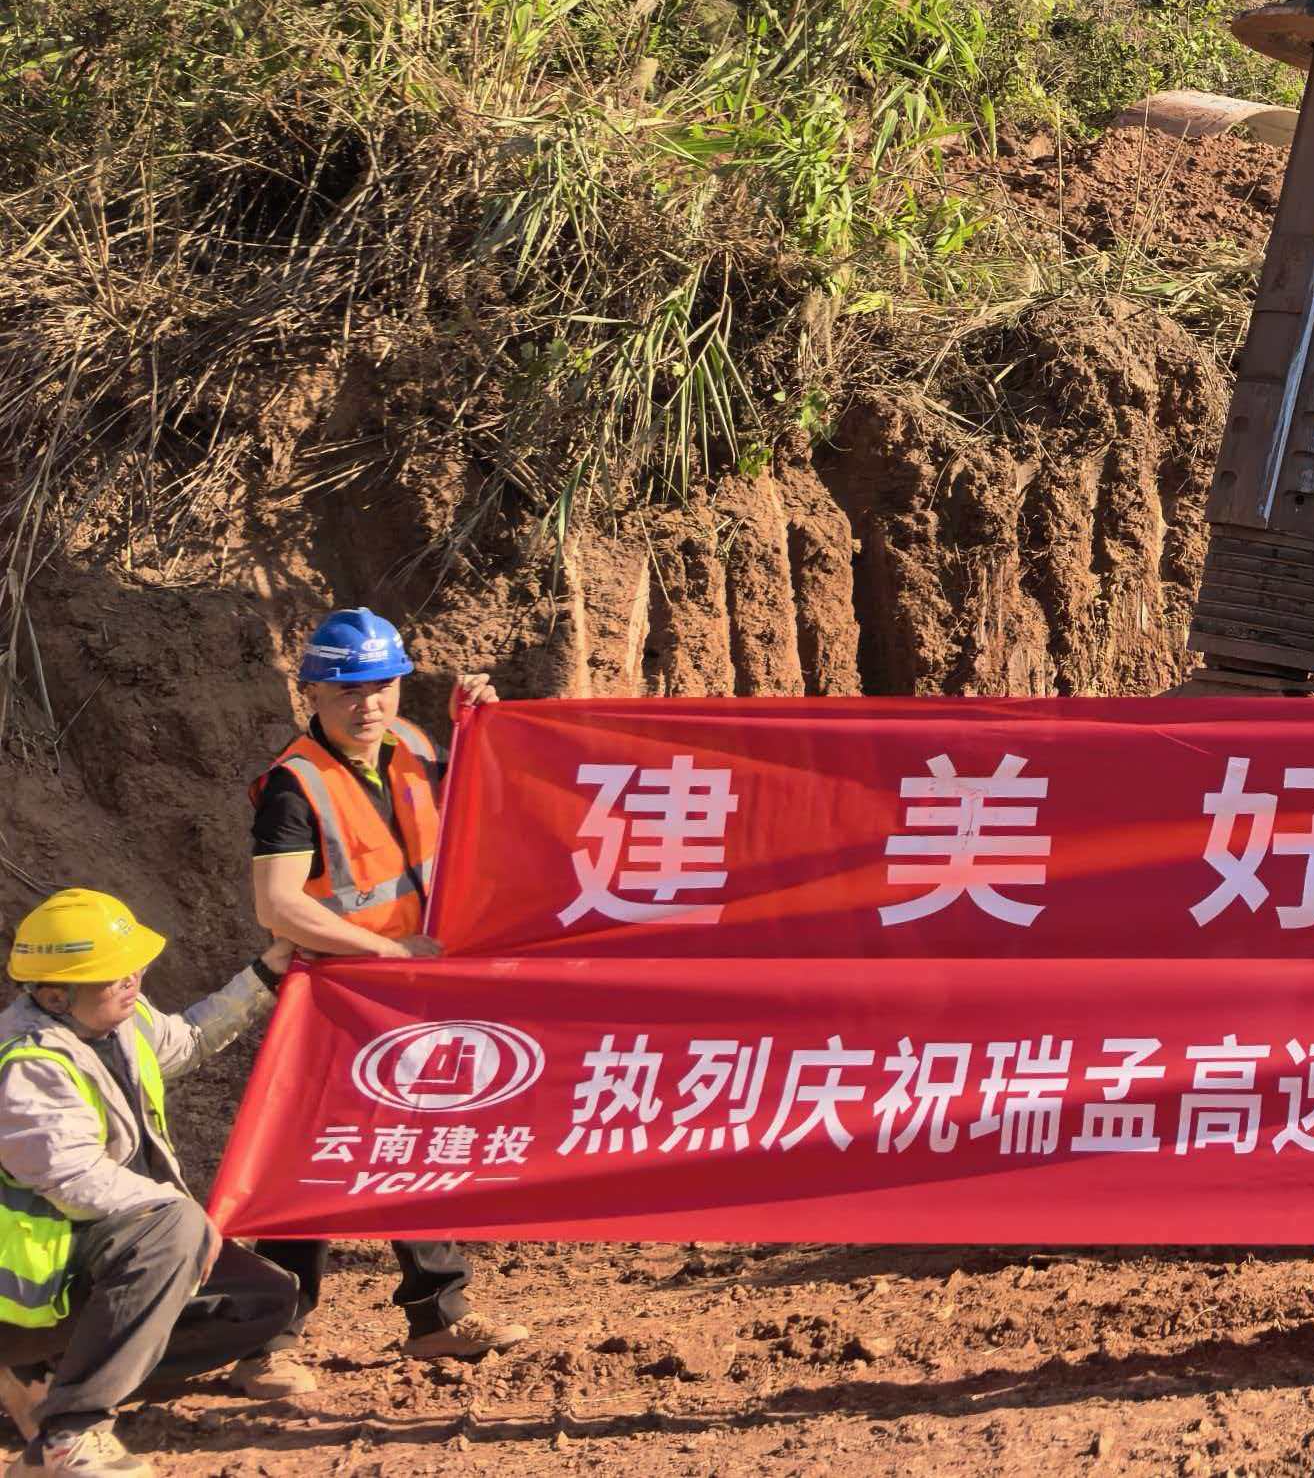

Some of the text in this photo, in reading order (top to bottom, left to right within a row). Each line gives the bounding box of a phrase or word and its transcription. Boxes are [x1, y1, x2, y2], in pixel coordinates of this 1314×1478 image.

[311, 1124, 535, 1165] 云南建投
[346, 1171, 475, 1195] YCIH
